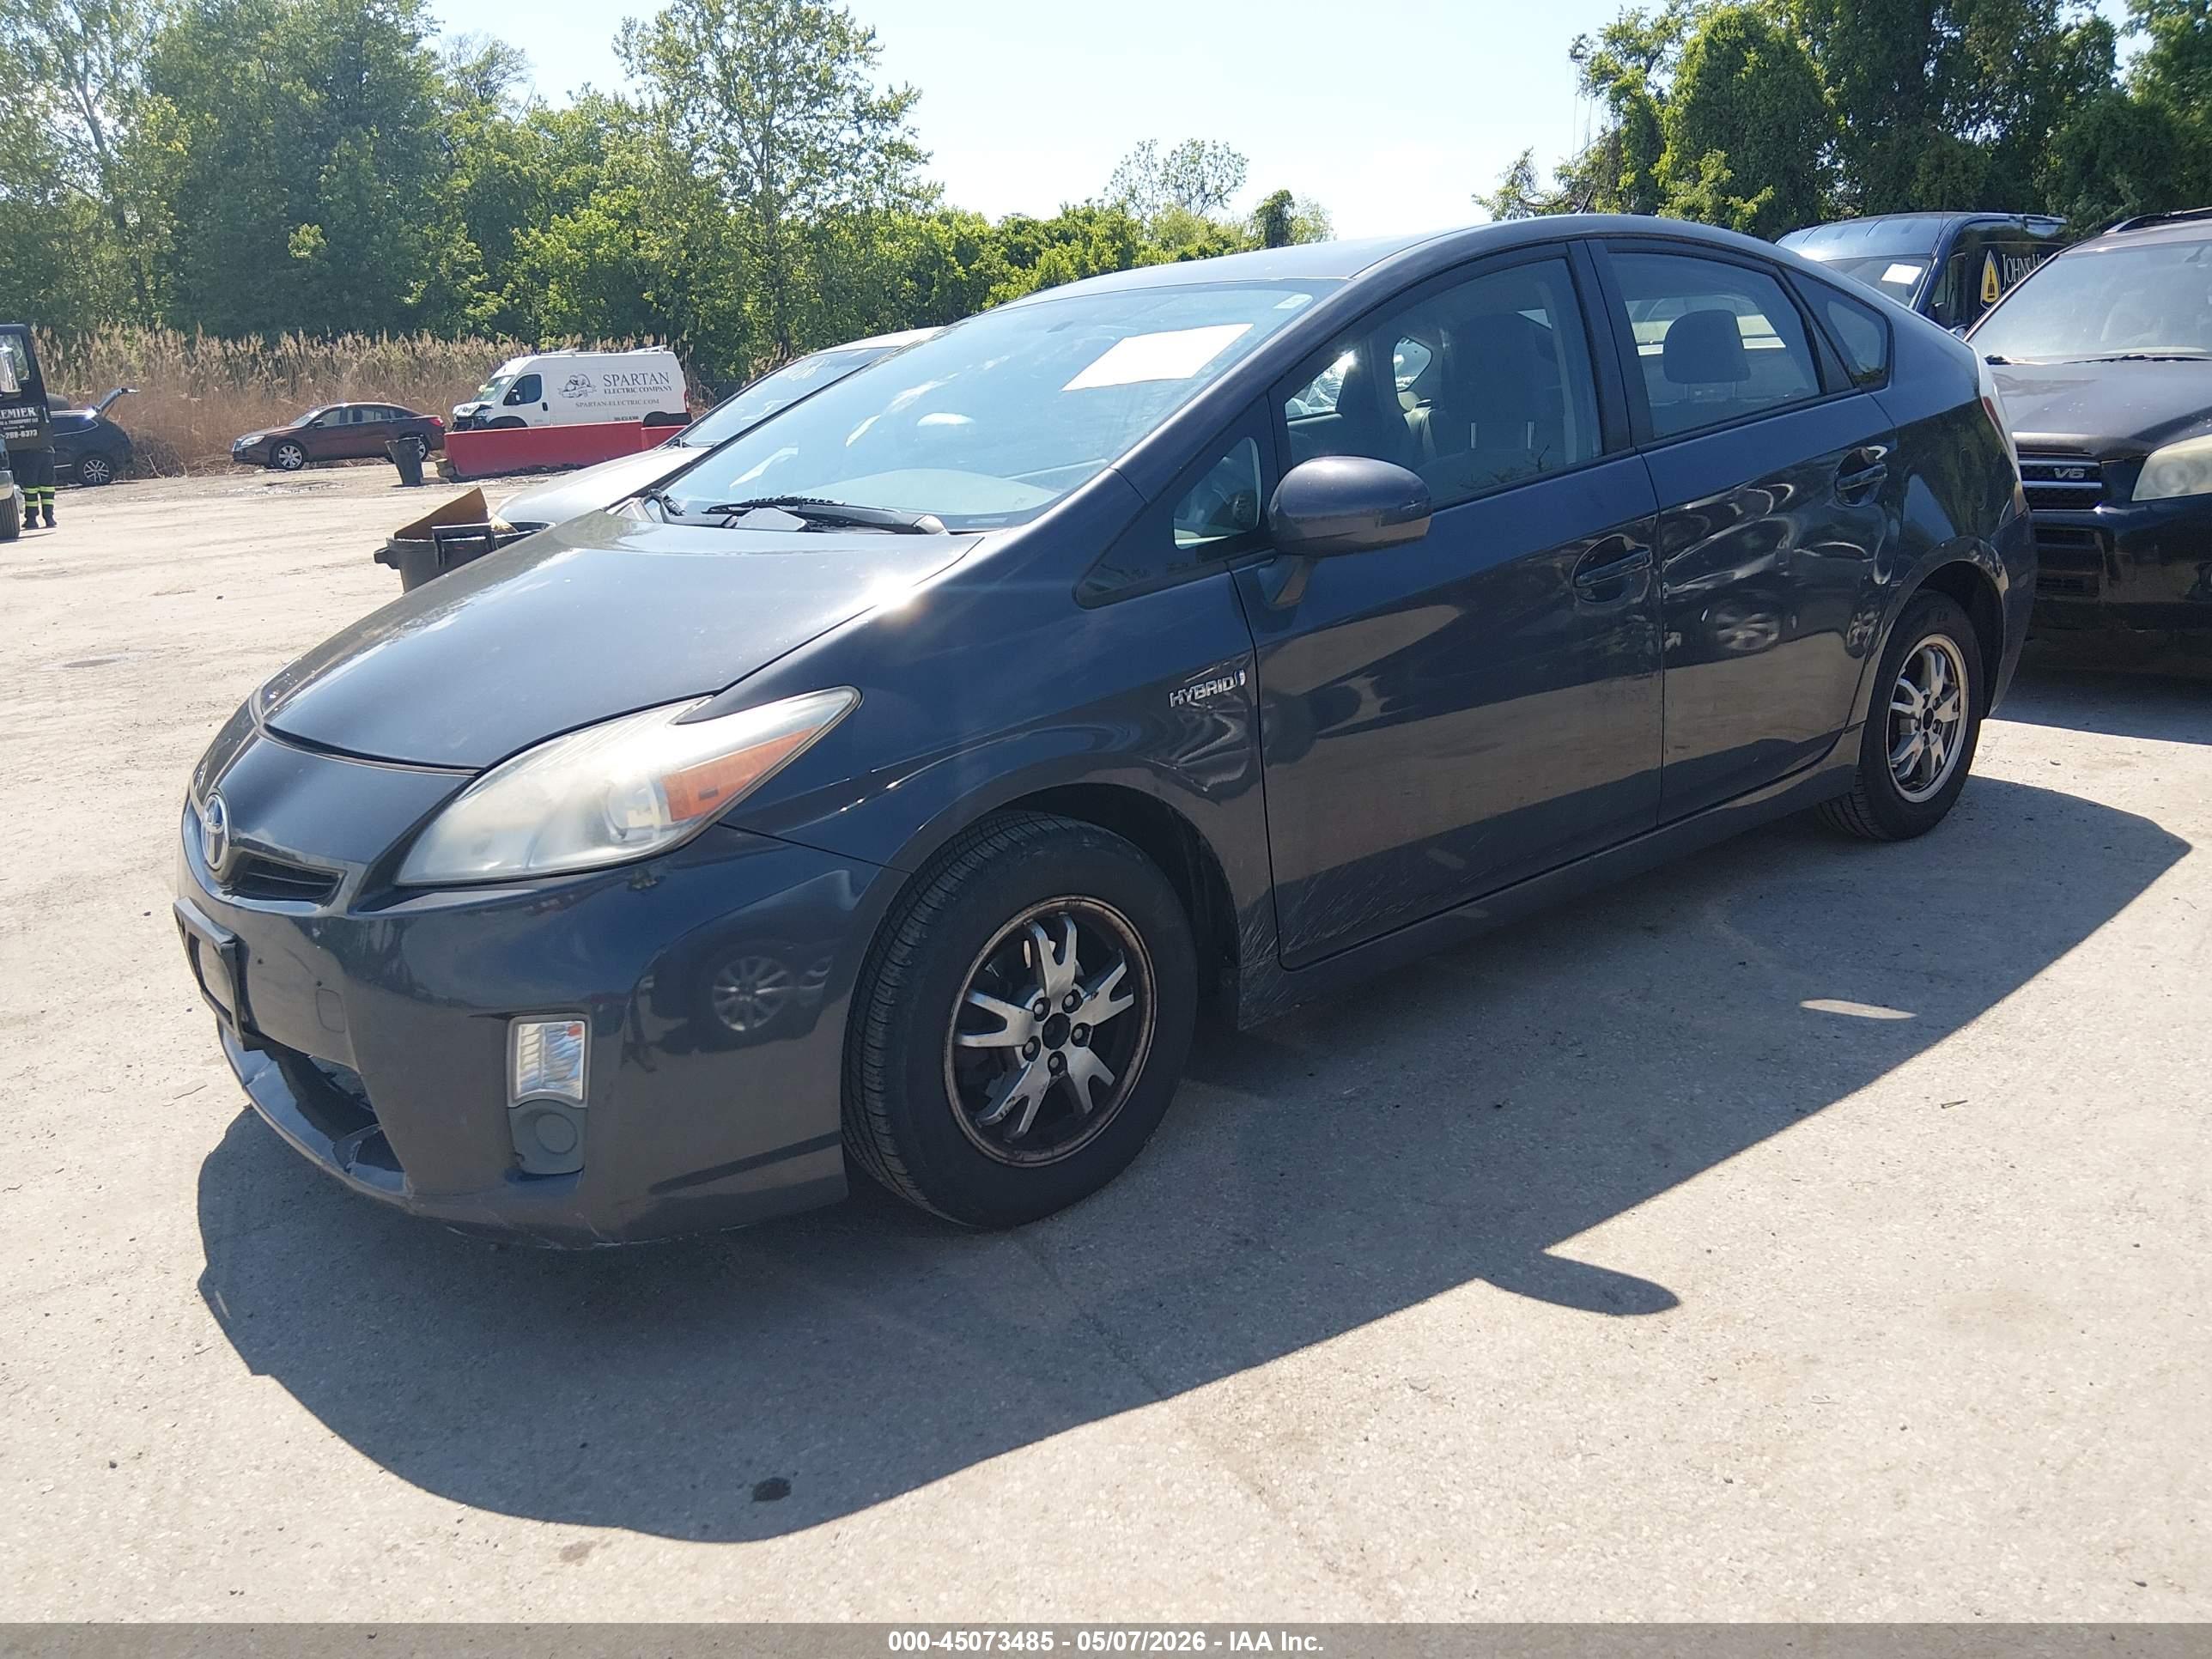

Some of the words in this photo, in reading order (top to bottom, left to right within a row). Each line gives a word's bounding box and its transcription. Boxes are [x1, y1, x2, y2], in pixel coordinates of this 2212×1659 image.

[603, 372, 670, 387] SPARTAN
[639, 385, 672, 393] COMPANY
[0, 406, 38, 420] EMIER
[2053, 467, 2086, 479] V6
[1169, 675, 1238, 708] HYBRID
